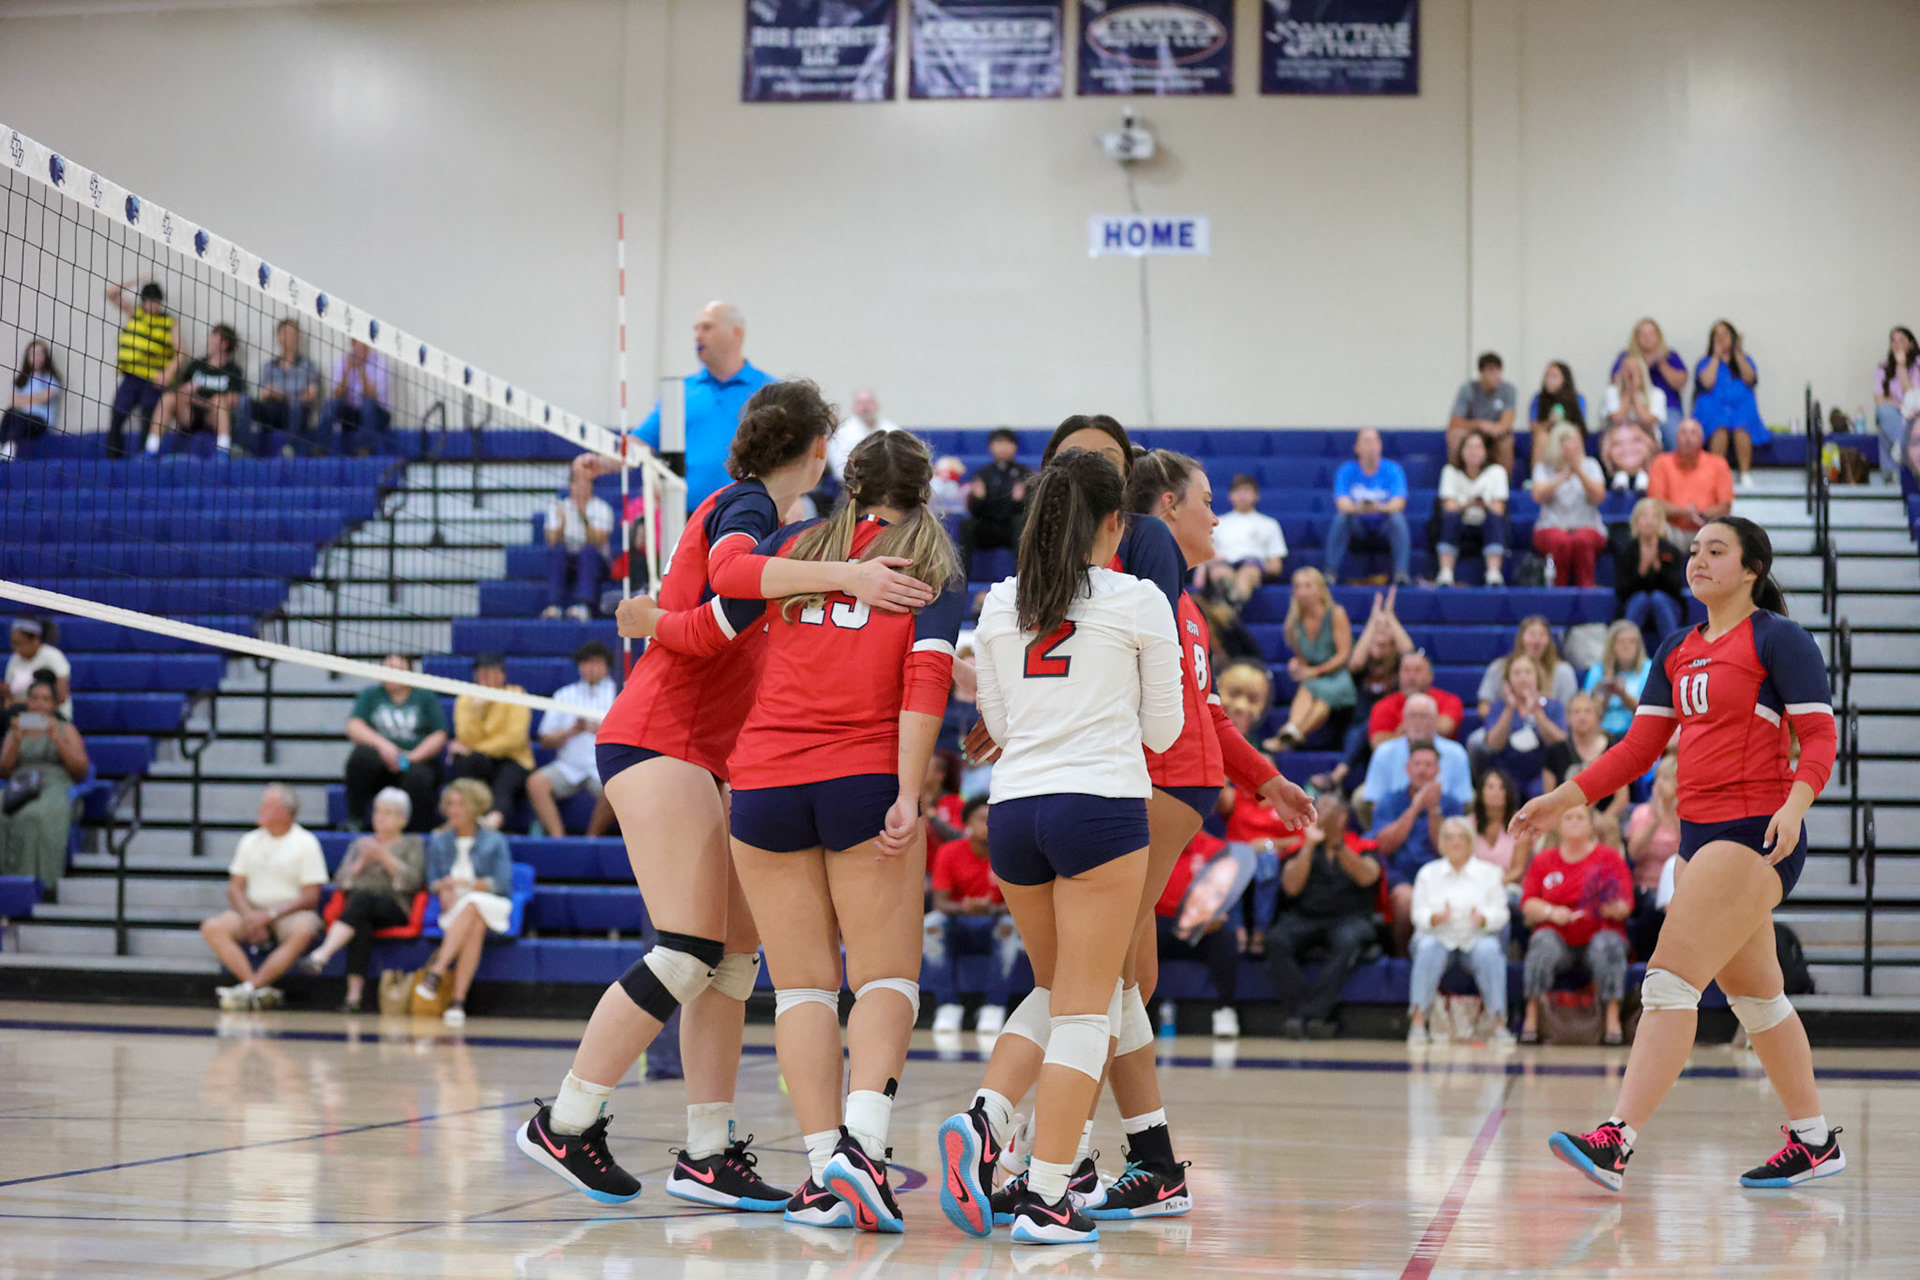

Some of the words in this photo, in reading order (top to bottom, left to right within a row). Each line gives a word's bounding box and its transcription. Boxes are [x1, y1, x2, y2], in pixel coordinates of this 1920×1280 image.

[1104, 222, 1195, 248] HOME
[1023, 619, 1077, 678] 2
[1192, 641, 1209, 691] 8
[1679, 671, 1710, 717] 10
